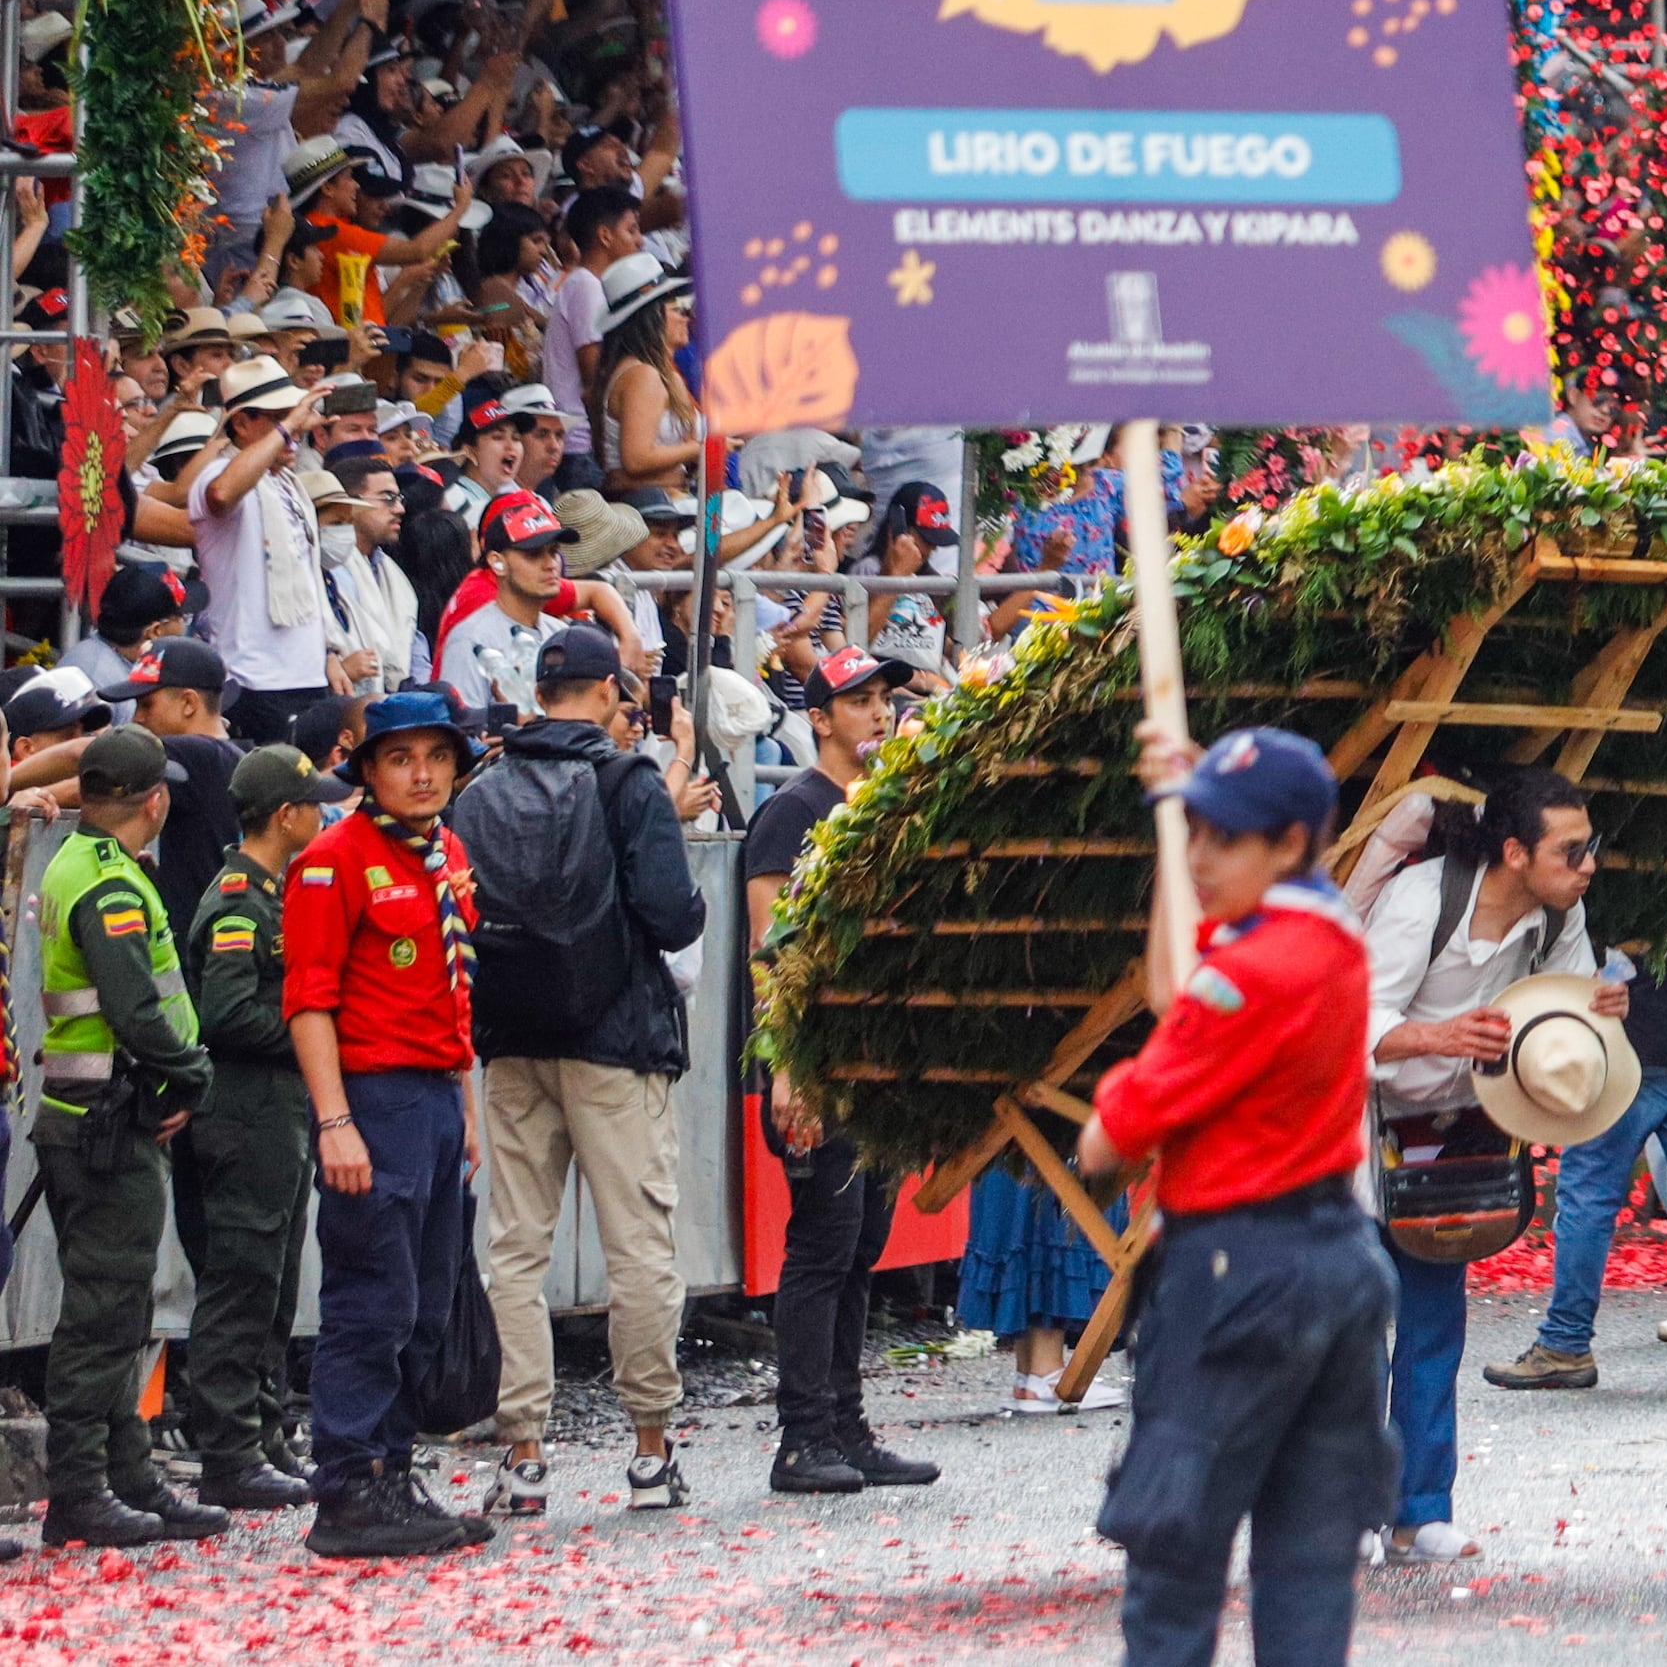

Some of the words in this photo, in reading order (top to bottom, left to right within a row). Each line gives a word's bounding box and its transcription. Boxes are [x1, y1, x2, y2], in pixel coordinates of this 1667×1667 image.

[929, 130, 1060, 177] LIRIO
[1066, 131, 1137, 177] DE
[1143, 132, 1313, 179] FUEGO
[894, 208, 1076, 245] ELEMENTS
[1078, 210, 1204, 245] DANZA
[1198, 211, 1230, 245] Y
[1231, 211, 1360, 246] KIPARA
